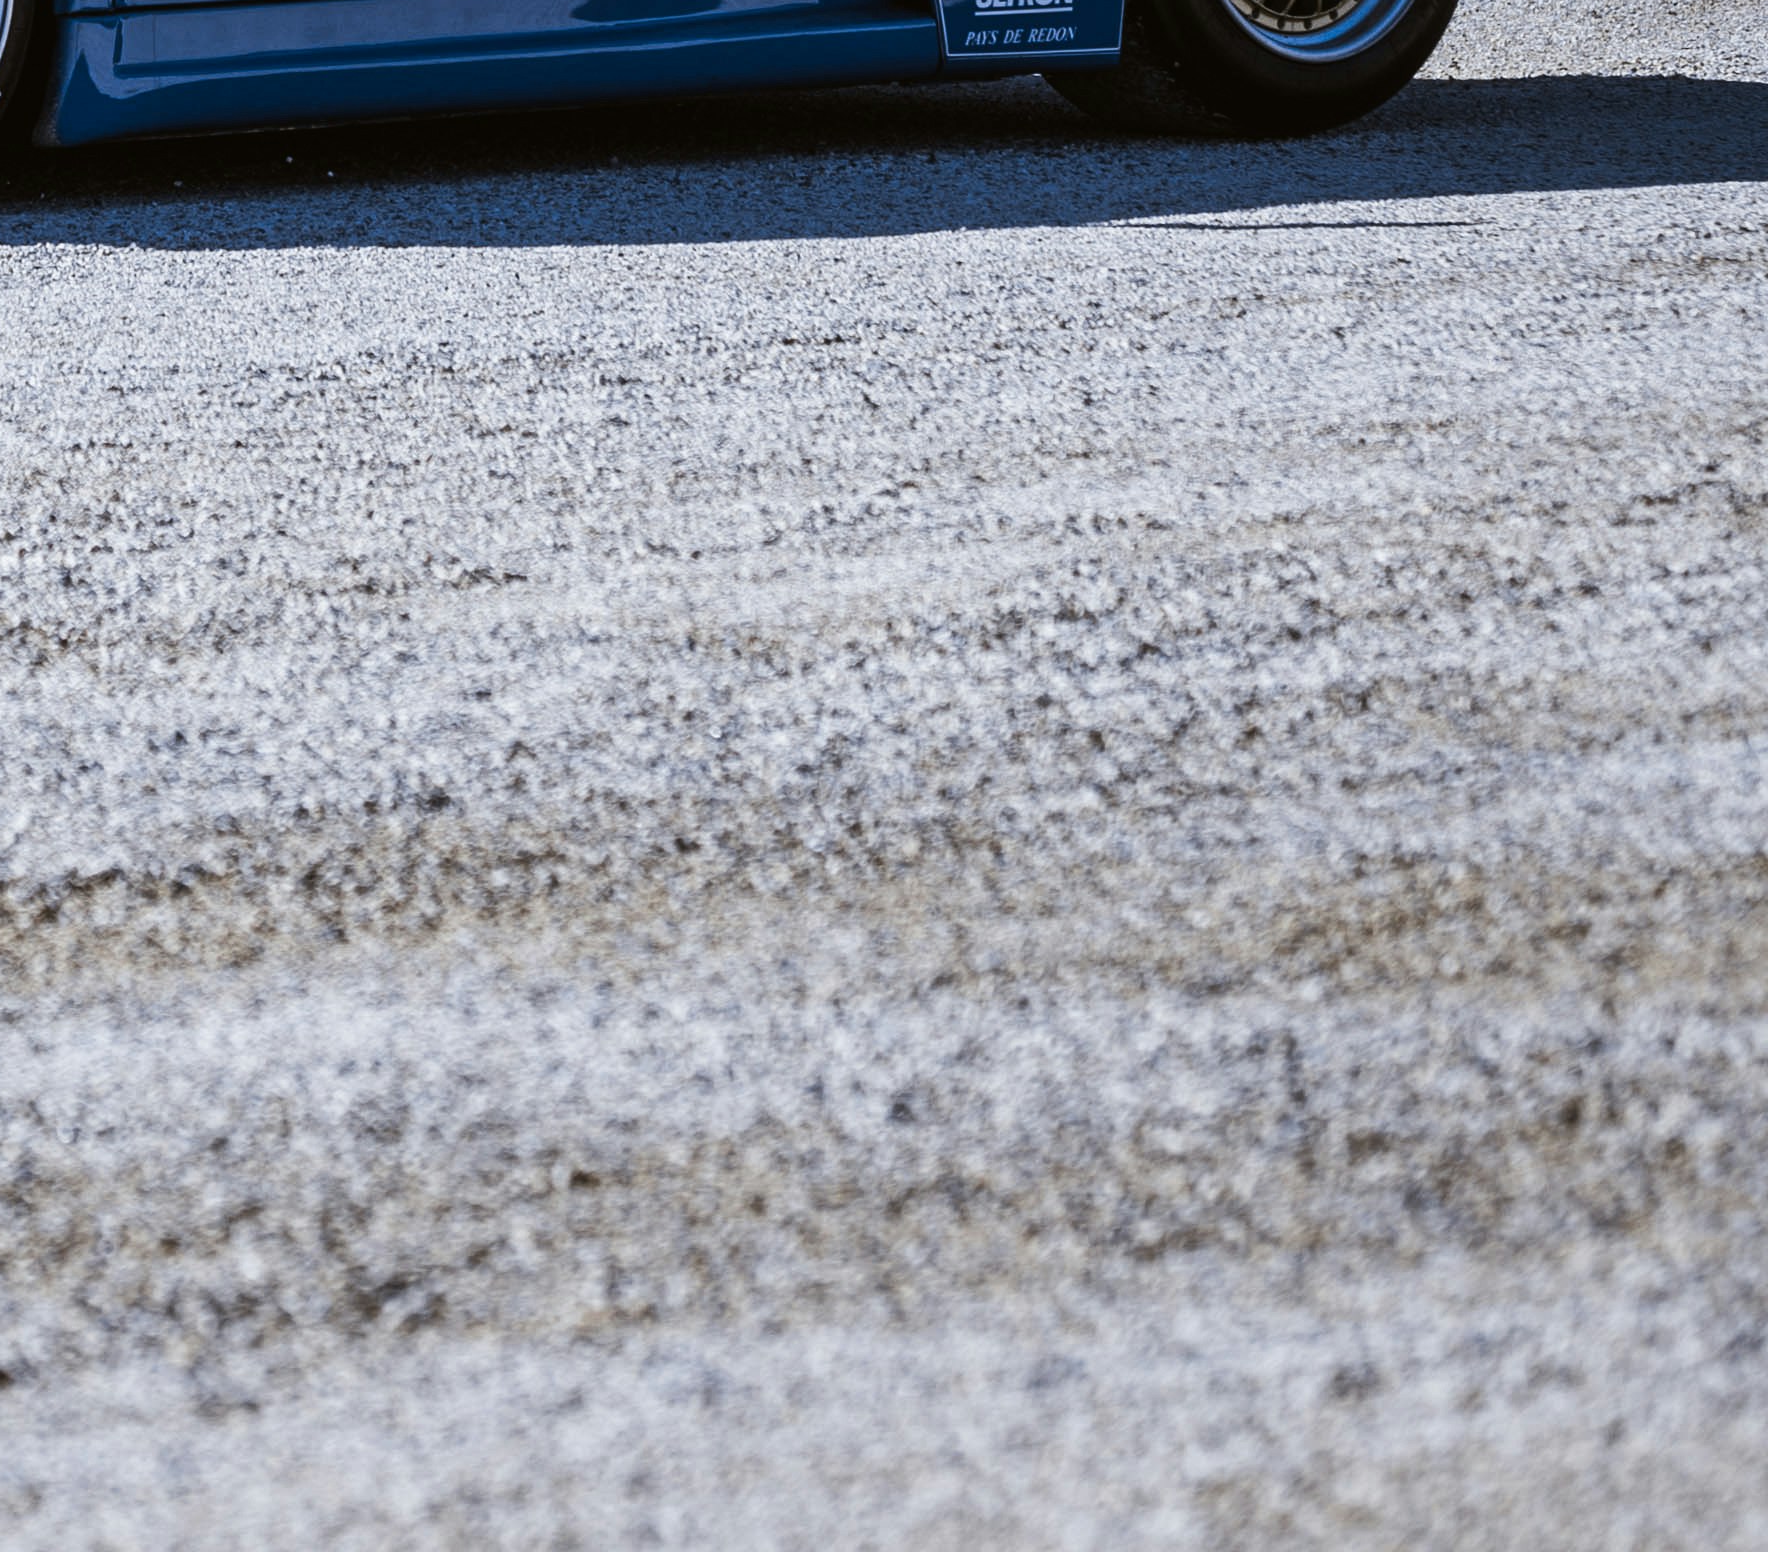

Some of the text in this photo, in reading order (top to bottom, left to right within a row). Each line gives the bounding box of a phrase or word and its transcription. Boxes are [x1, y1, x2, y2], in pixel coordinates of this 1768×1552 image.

[964, 26, 1079, 47] PAYS DE REDON
